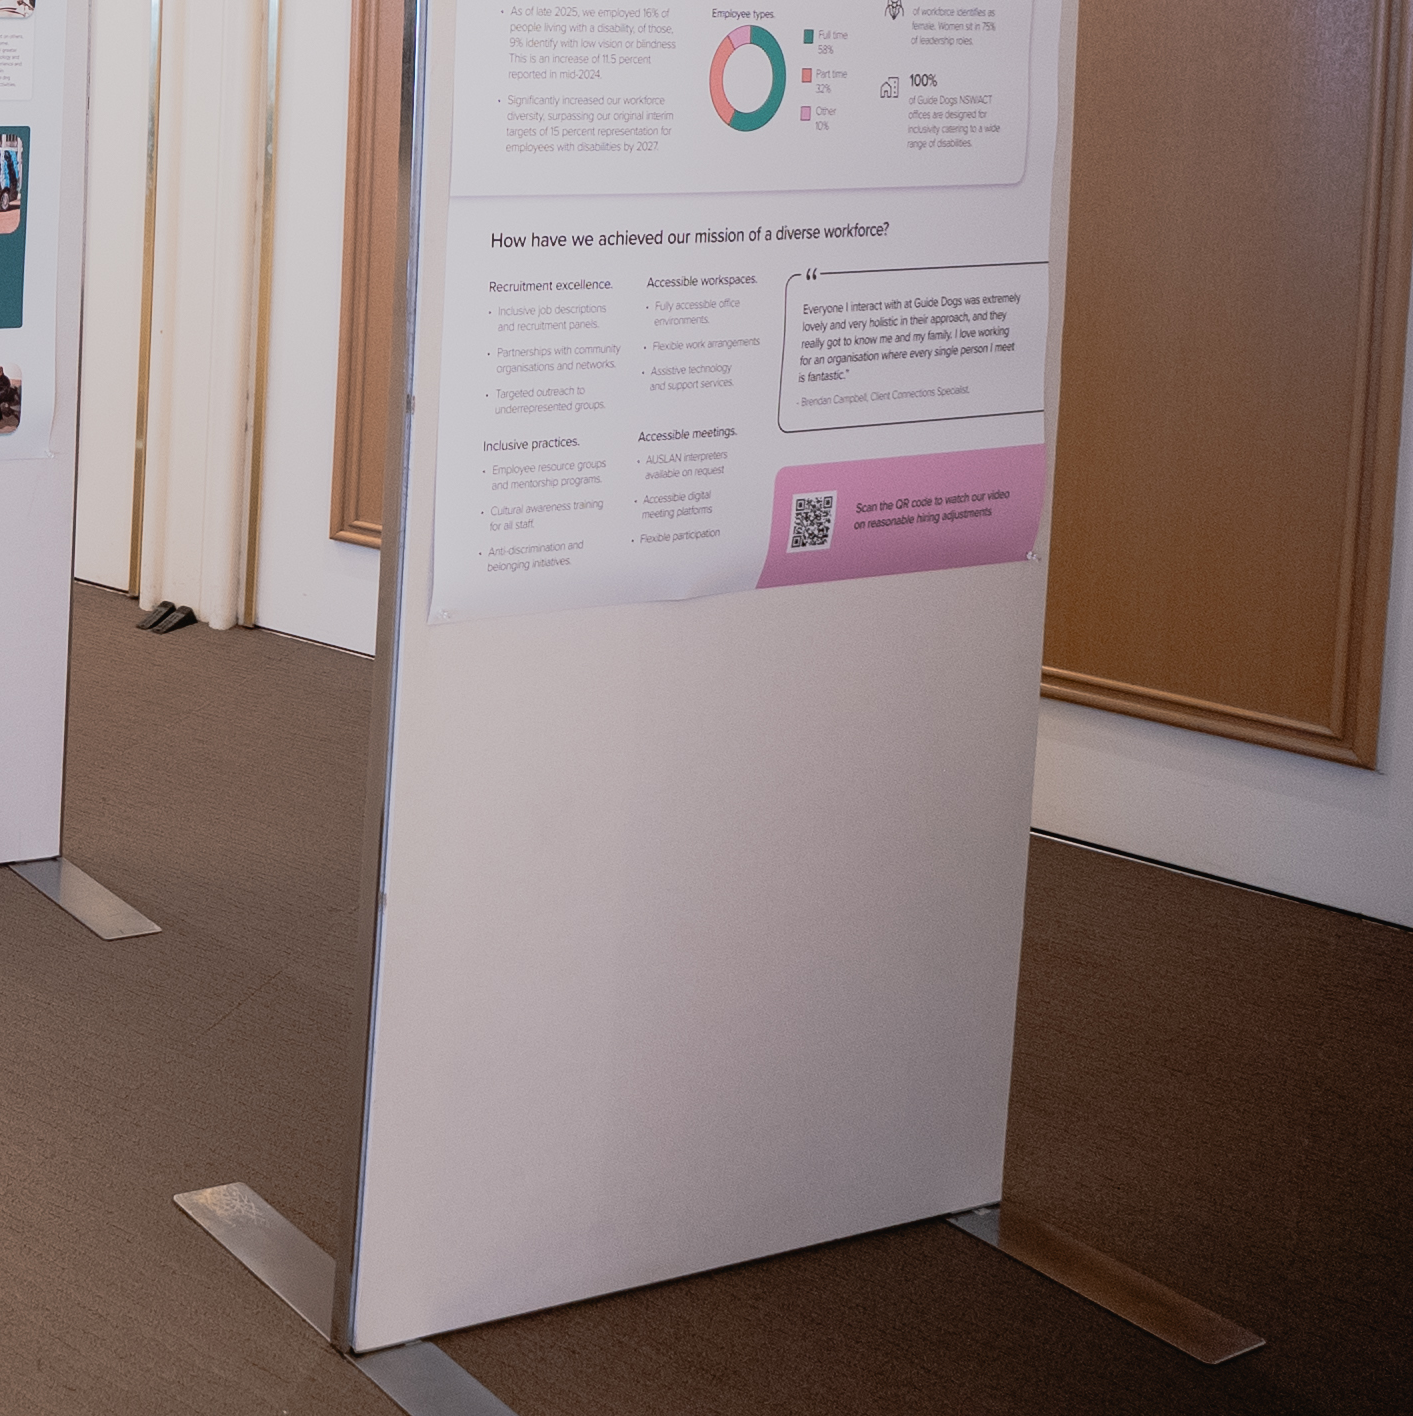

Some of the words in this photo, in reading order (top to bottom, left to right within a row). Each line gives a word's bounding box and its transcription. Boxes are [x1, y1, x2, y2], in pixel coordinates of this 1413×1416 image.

[712, 8, 751, 21] Employee
[909, 73, 938, 87] 100%
[491, 232, 527, 248] How
[531, 232, 567, 247] have
[571, 234, 594, 247] we
[598, 230, 663, 246] achieved
[667, 232, 691, 245] our
[695, 227, 744, 243] mission
[748, 226, 762, 242] of
[764, 229, 772, 241] a
[775, 225, 821, 241] diverse
[823, 221, 890, 238] workforce?
[489, 281, 553, 293] Recruitment
[555, 279, 613, 291] excellence.
[646, 276, 699, 288] Accessible
[700, 275, 758, 287] workspaces.
[637, 429, 690, 442] Accessible
[692, 427, 737, 439] meetings.
[483, 440, 529, 452] Inclusive
[531, 438, 580, 452] practices.
[855, 502, 878, 514] Scan
[879, 500, 894, 512] the
[895, 498, 910, 510] QR
[911, 497, 933, 508] code
[934, 497, 944, 506] to
[945, 492, 970, 505] watch
[971, 493, 986, 502] our
[987, 489, 1010, 501] video
[853, 520, 866, 530] on
[867, 515, 915, 528] reasonable
[916, 513, 940, 524] hiring
[940, 507, 992, 523] adjustments
